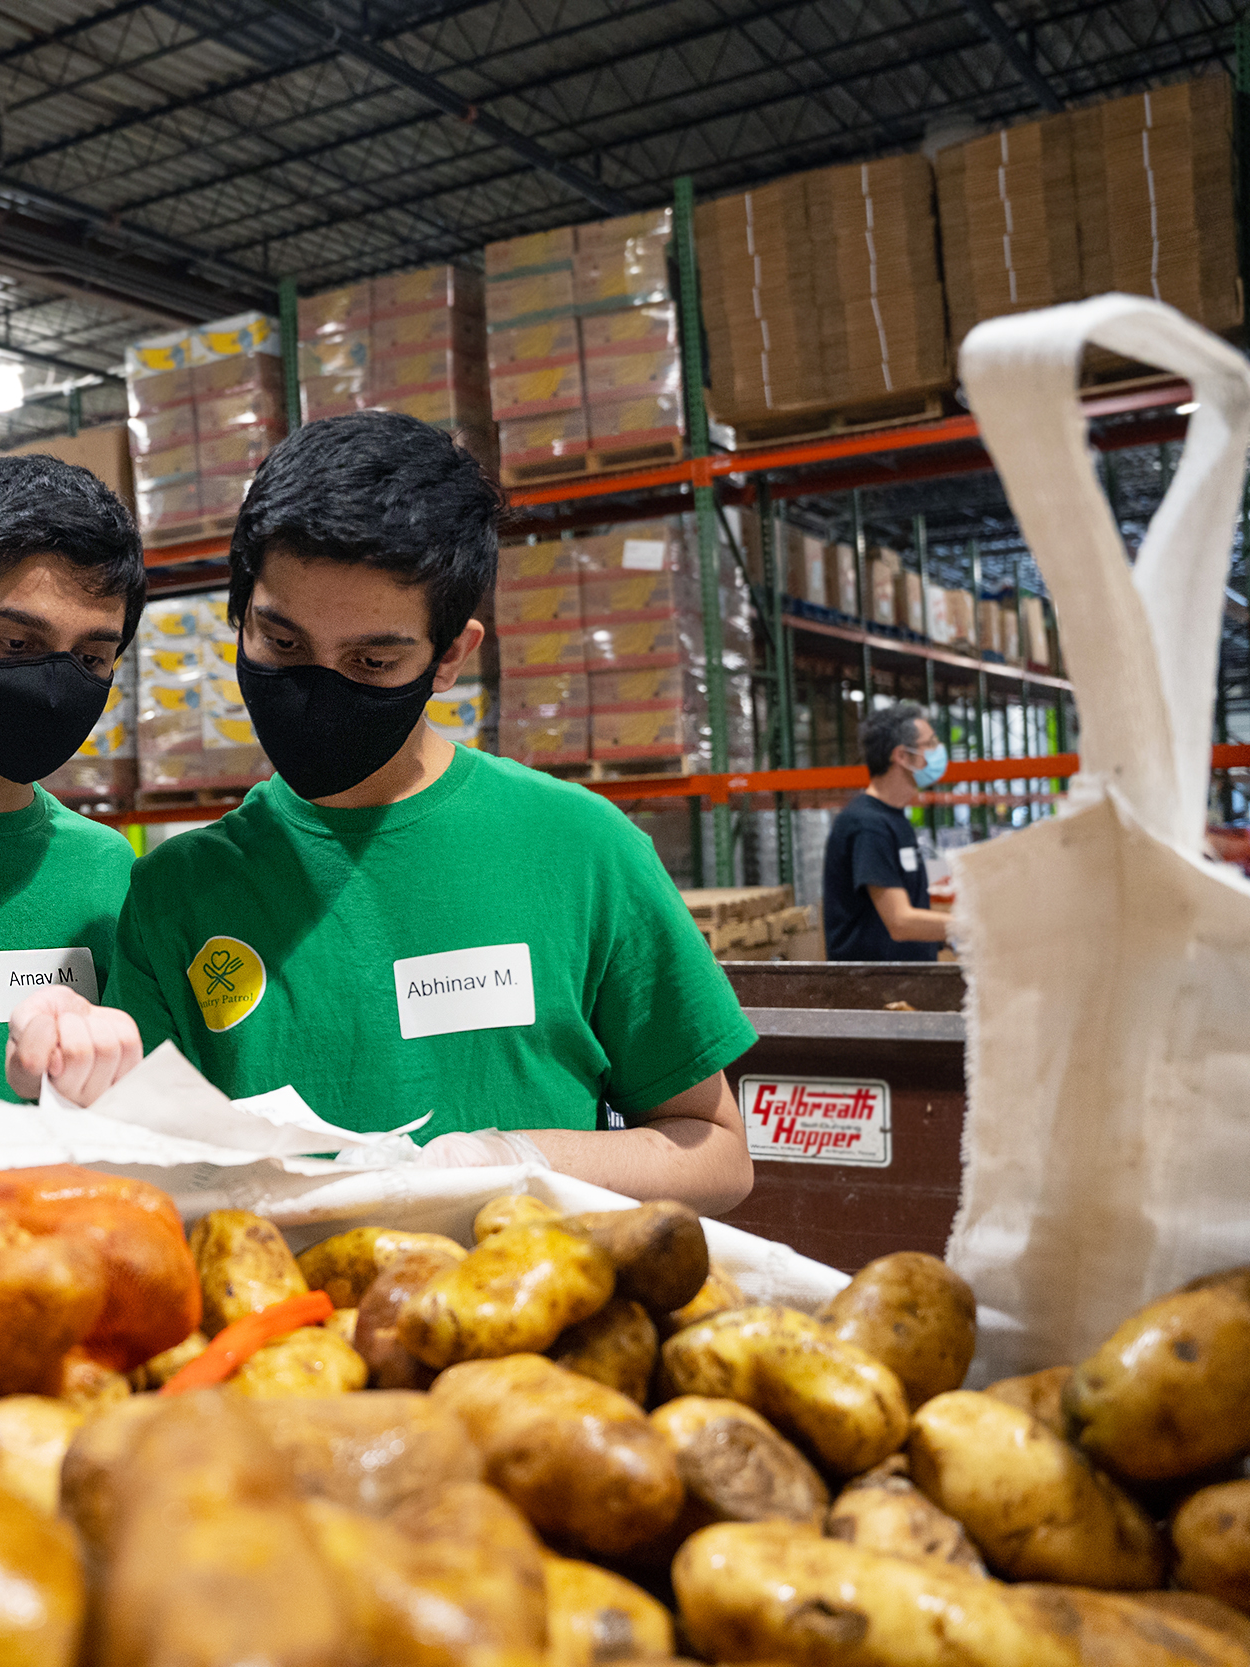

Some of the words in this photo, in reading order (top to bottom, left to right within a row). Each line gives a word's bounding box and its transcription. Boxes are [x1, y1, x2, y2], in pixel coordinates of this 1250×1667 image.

[9, 971, 53, 987] Arnav
[57, 967, 79, 983] M.
[407, 975, 487, 999] Abhinav
[493, 968, 518, 987] M.
[222, 992, 254, 1004] Patrol
[752, 1084, 877, 1126] Galbreath
[772, 1116, 861, 1155] Hopper
